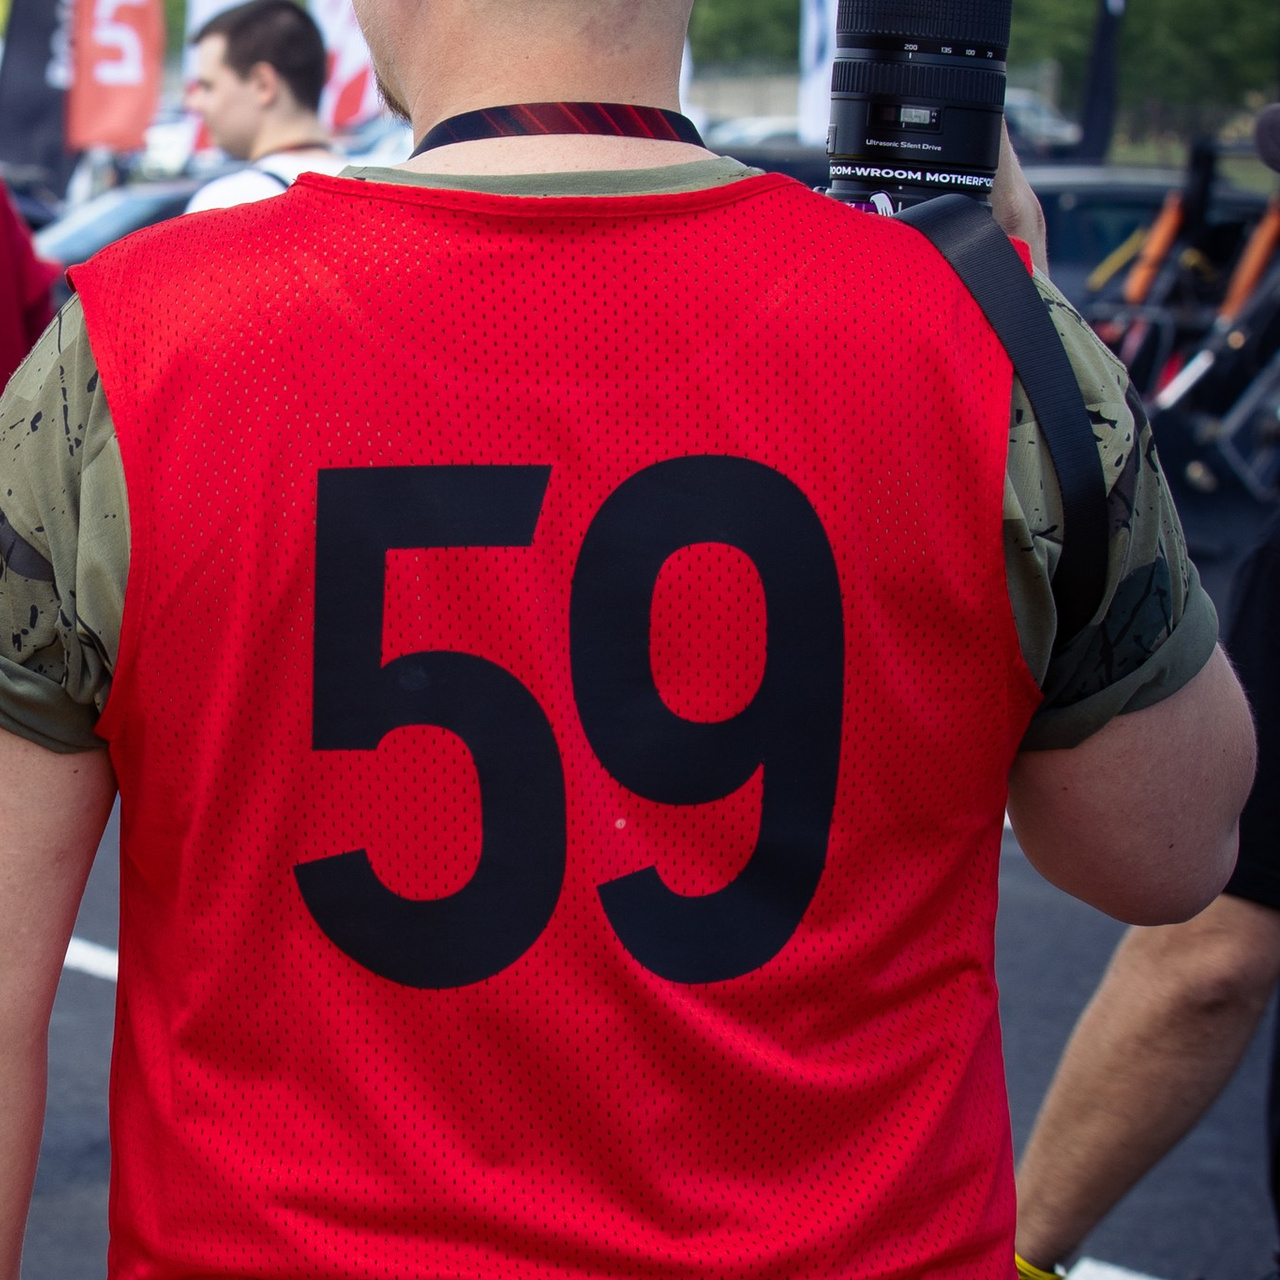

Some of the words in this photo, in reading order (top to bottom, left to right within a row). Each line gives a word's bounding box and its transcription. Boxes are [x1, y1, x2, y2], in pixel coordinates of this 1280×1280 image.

[866, 139, 899, 148] Ultrasonic
[900, 141, 921, 150] Silent
[922, 143, 942, 152] Drive
[830, 166, 921, 181] OOM-WROOM
[293, 454, 845, 990] 59
